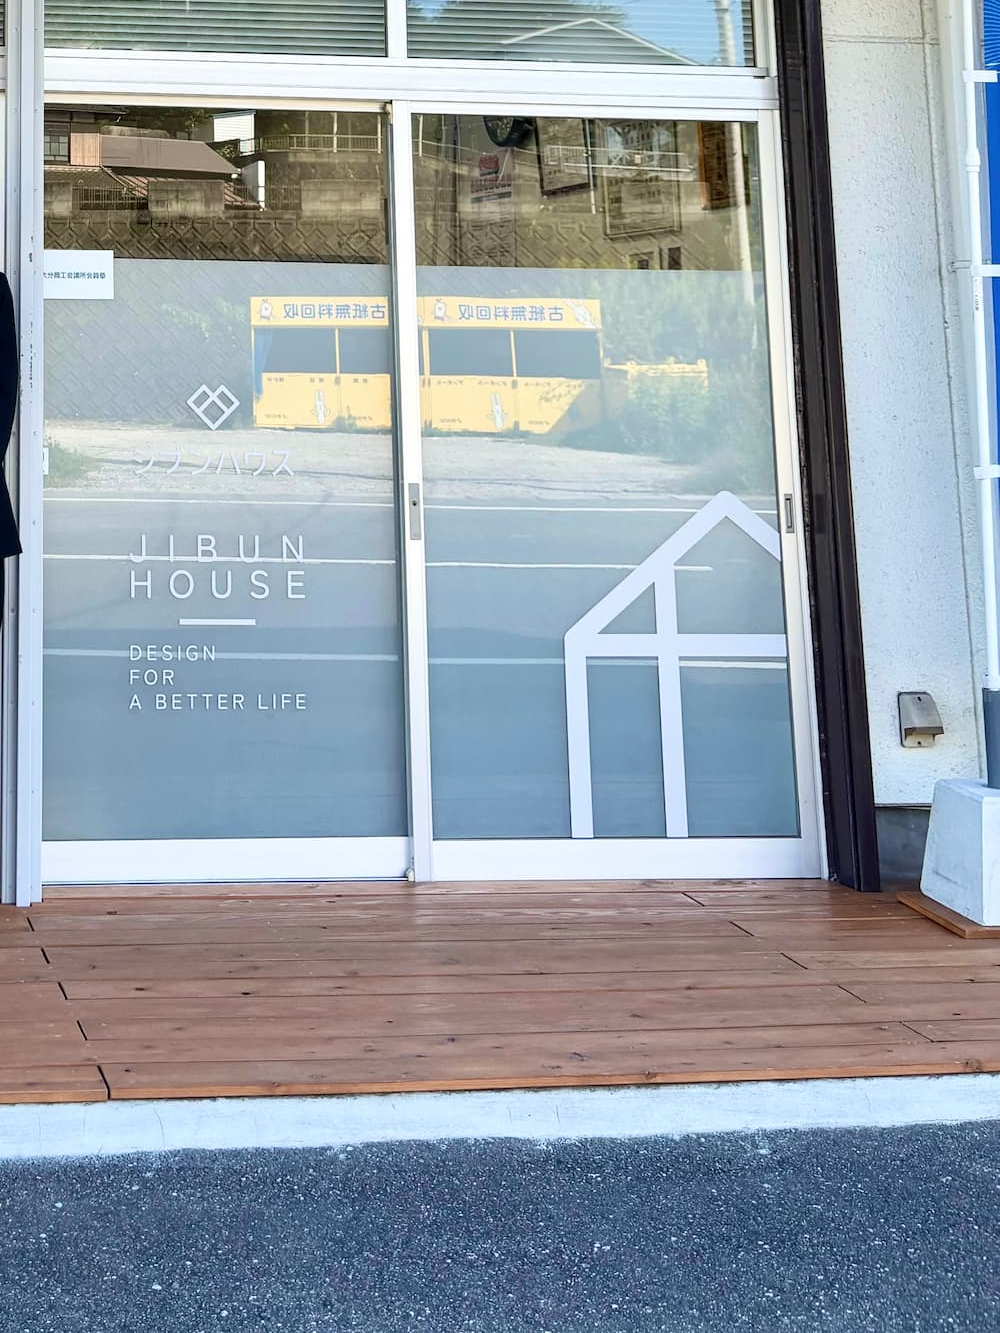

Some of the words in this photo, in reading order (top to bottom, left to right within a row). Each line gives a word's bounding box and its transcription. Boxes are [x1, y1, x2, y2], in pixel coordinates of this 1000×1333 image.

[133, 445, 295, 476] ジブンハウス
[129, 534, 304, 563] JIBUN
[129, 570, 306, 599] HOUSE
[129, 645, 217, 661] DESIGN
[129, 669, 175, 685] FOR
[129, 693, 142, 710] A
[155, 693, 245, 710] BETTER
[257, 693, 307, 710] LIFE
